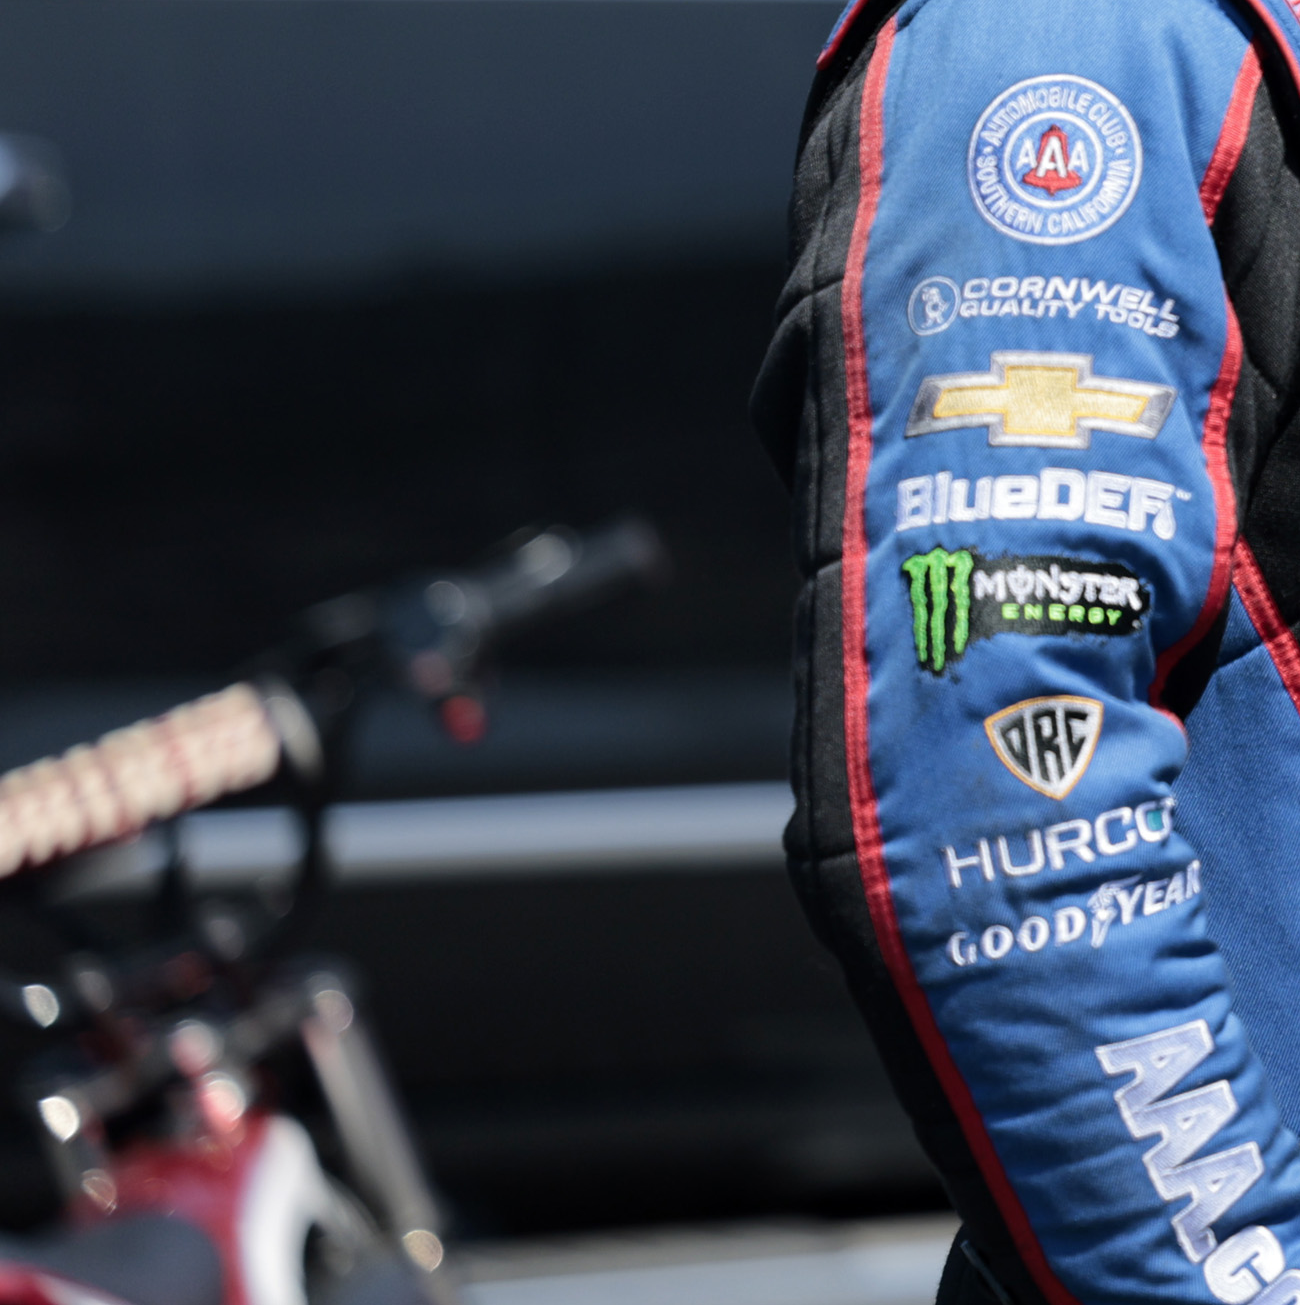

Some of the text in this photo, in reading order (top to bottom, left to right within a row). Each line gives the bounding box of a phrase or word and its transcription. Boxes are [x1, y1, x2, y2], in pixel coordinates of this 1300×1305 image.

[980, 86, 1129, 149] AUTOMOBILE CLUB
[1015, 135, 1090, 179] AAA
[976, 155, 1132, 235] SOUTHERN CALIFORNIA
[959, 298, 1181, 339] QUALITY TOOLS
[962, 275, 1180, 323] CORNWELL
[895, 466, 1178, 537] BlueDEF
[973, 562, 1142, 612] MONSTER
[1001, 602, 1123, 626] ENERGY
[941, 803, 1172, 890] HURCO
